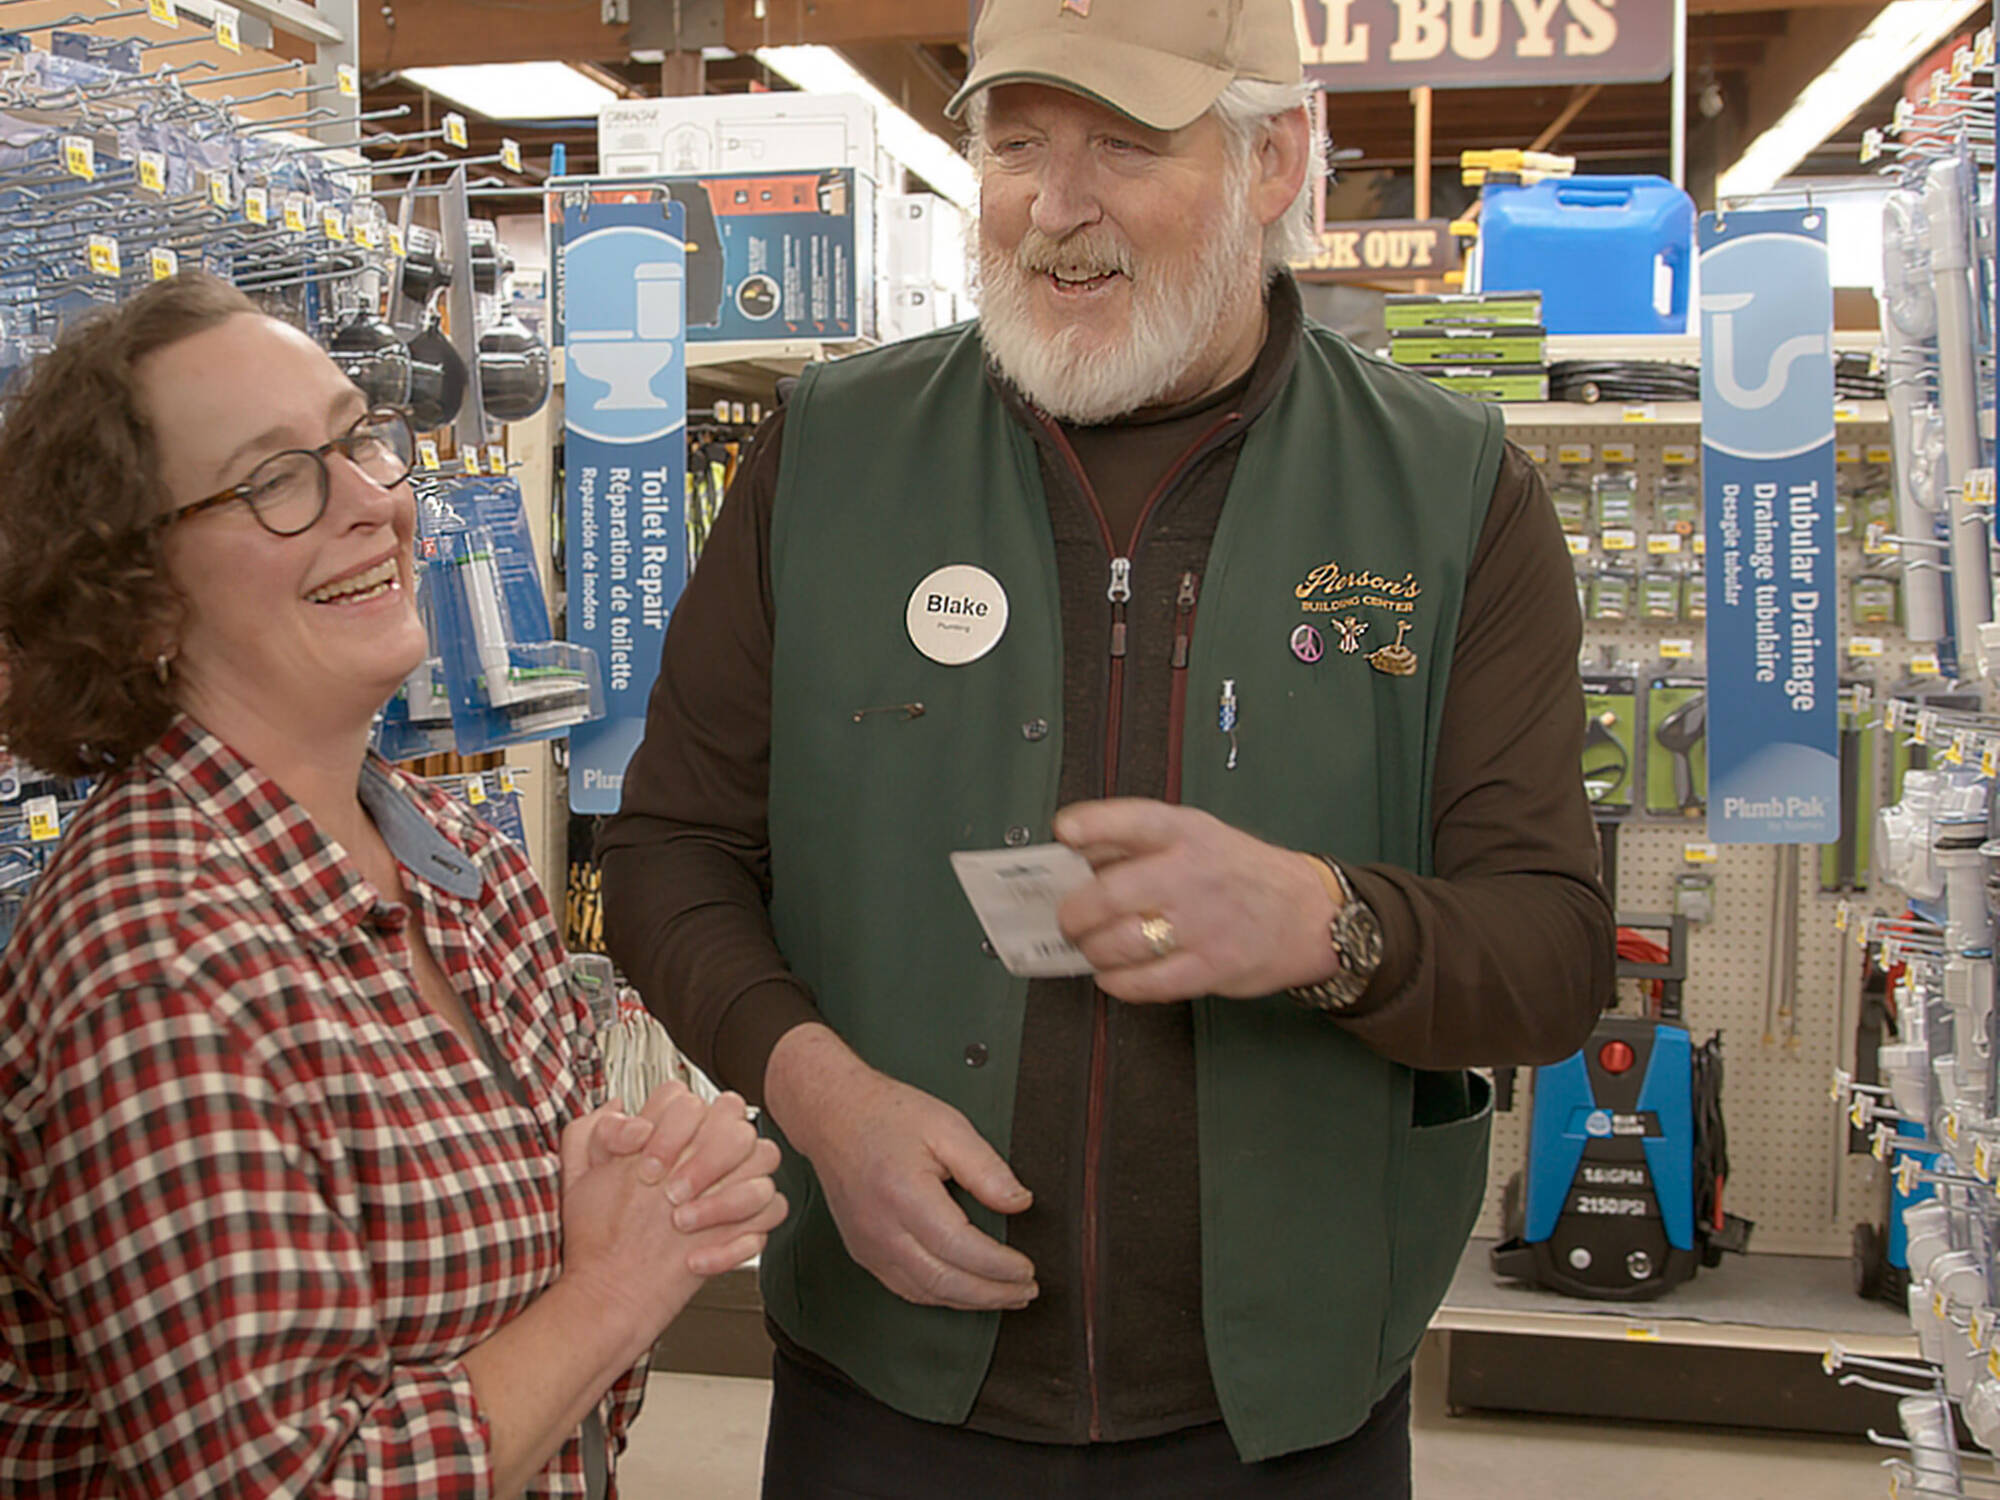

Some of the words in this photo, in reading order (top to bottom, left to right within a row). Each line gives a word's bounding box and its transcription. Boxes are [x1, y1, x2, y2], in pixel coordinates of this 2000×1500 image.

[1389, 0, 1617, 60] BUYS
[1290, 230, 1361, 269] CK
[1363, 229, 1437, 268] OUT
[579, 467, 599, 548] Reparación
[605, 467, 632, 580] Réparation
[642, 467, 669, 538] Toilet
[1749, 483, 1779, 580] Drainage
[1789, 480, 1820, 584] Tubular
[583, 551, 599, 570] de
[636, 546, 670, 630] Repair
[1295, 561, 1422, 598] Pierson's
[1724, 550, 1743, 606] tubular
[583, 572, 599, 631] inodoro
[611, 586, 632, 612] de
[927, 594, 988, 617] Blake
[1302, 596, 1360, 612] BUILDING
[1362, 595, 1413, 612] CENTER
[611, 617, 633, 691] toilette
[1755, 585, 1781, 683] tubulaire
[1784, 591, 1821, 711] Drainage
